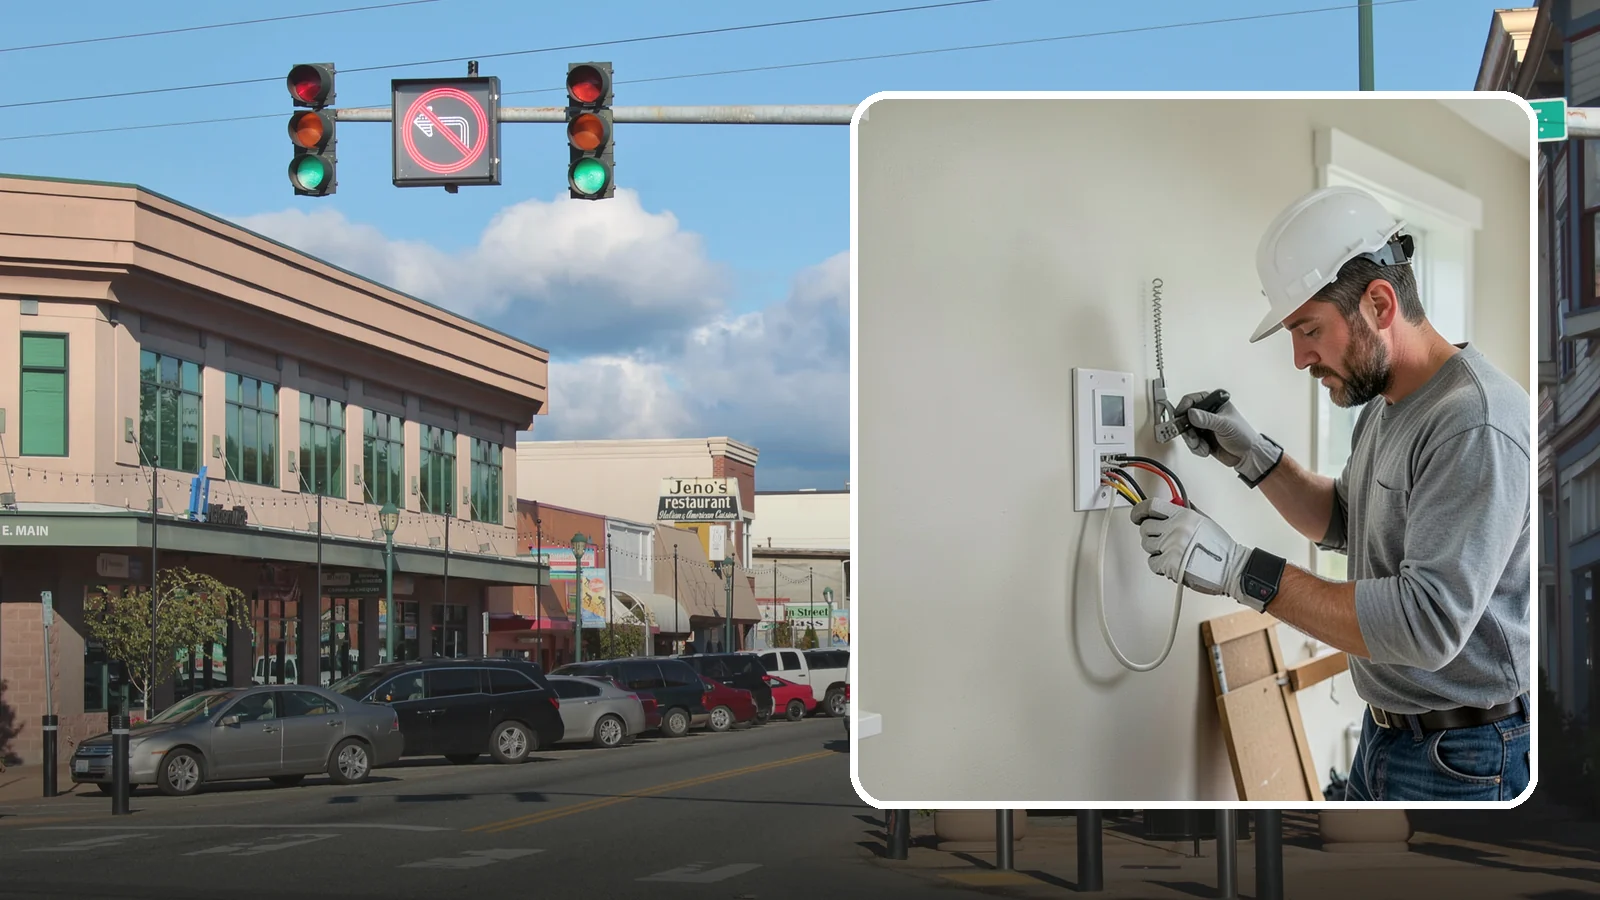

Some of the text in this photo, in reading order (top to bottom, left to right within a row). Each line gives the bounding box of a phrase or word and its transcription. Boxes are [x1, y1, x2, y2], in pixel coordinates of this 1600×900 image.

[669, 479, 728, 495] Jeno's
[665, 496, 731, 509] restaurant
[658, 509, 682, 520] Italian
[685, 509, 714, 520] American
[714, 509, 738, 519] Cuisine
[2, 525, 49, 536] E. MAIN
[797, 607, 828, 617] Street
[790, 619, 824, 627] lass
